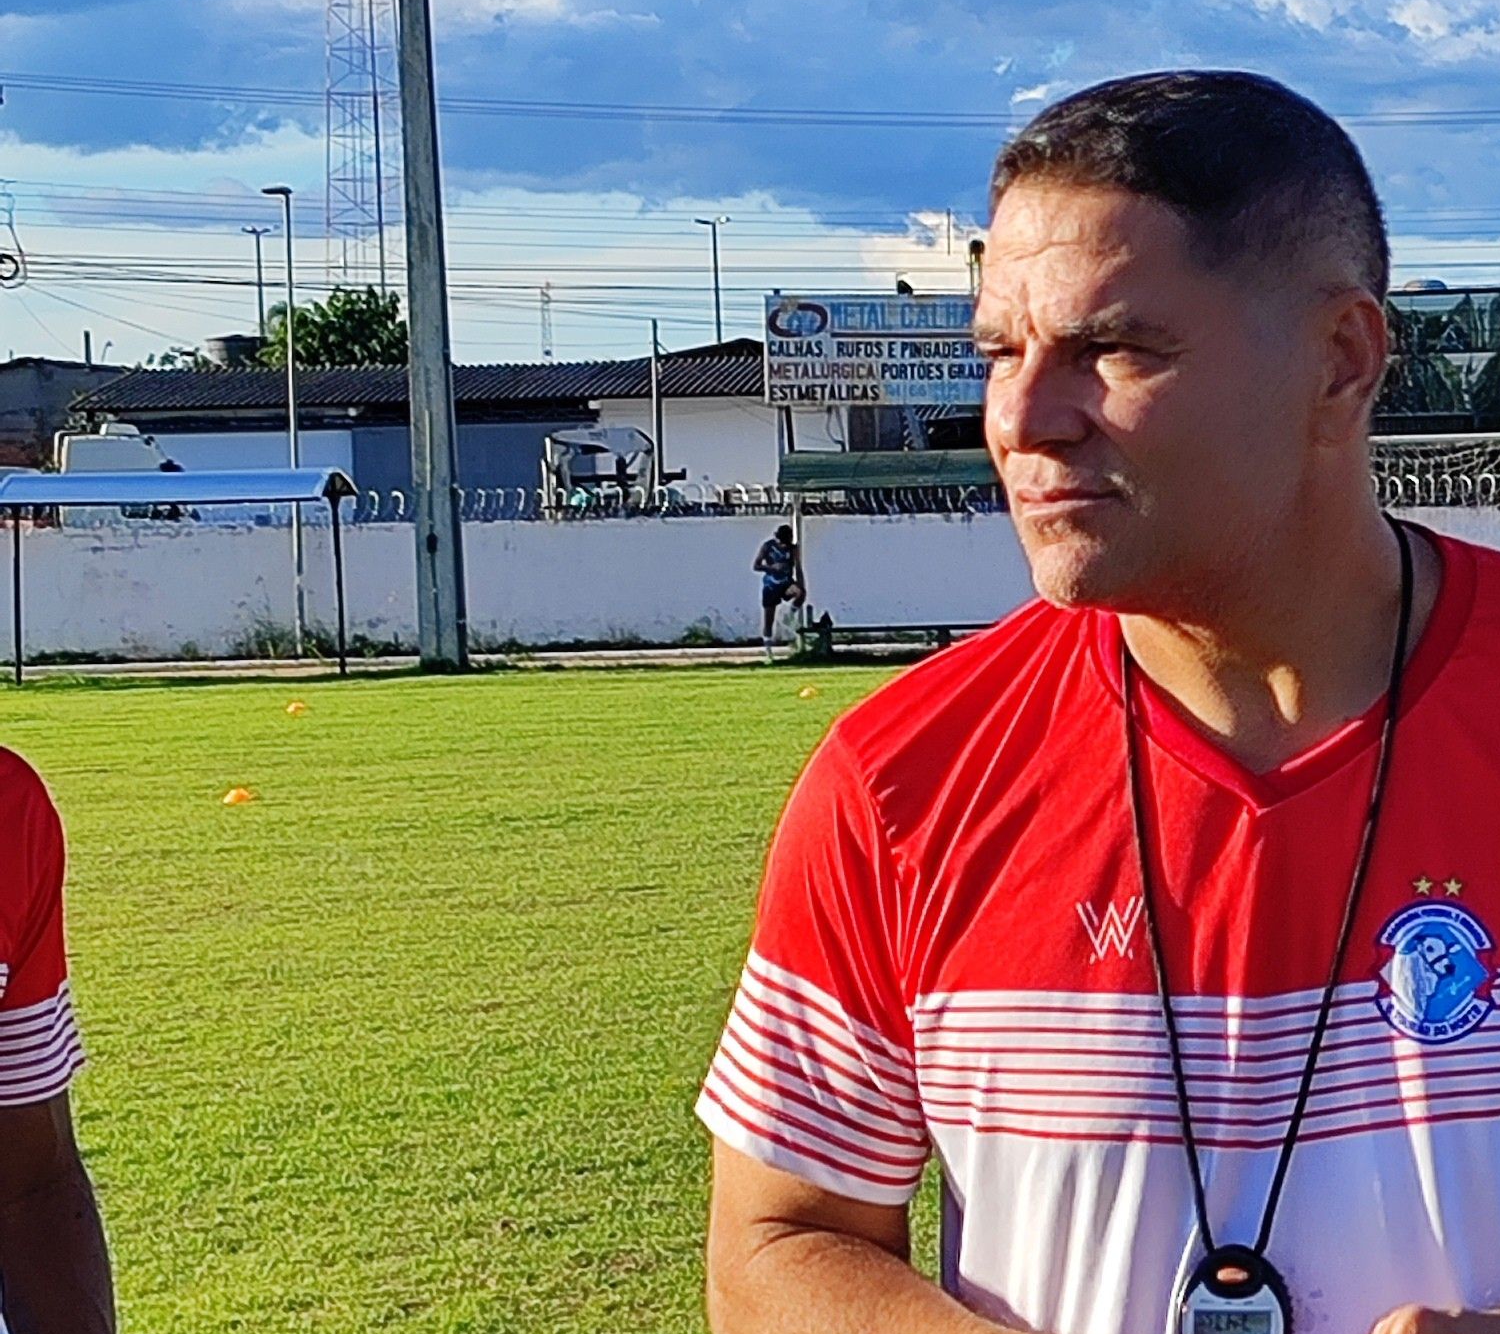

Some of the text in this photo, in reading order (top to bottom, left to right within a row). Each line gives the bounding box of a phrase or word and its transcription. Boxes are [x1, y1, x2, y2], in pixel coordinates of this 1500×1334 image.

[829, 302, 894, 330] METAL
[836, 340, 884, 359] RUFOS
[887, 340, 897, 359] E
[880, 359, 944, 381] PORTÕES
